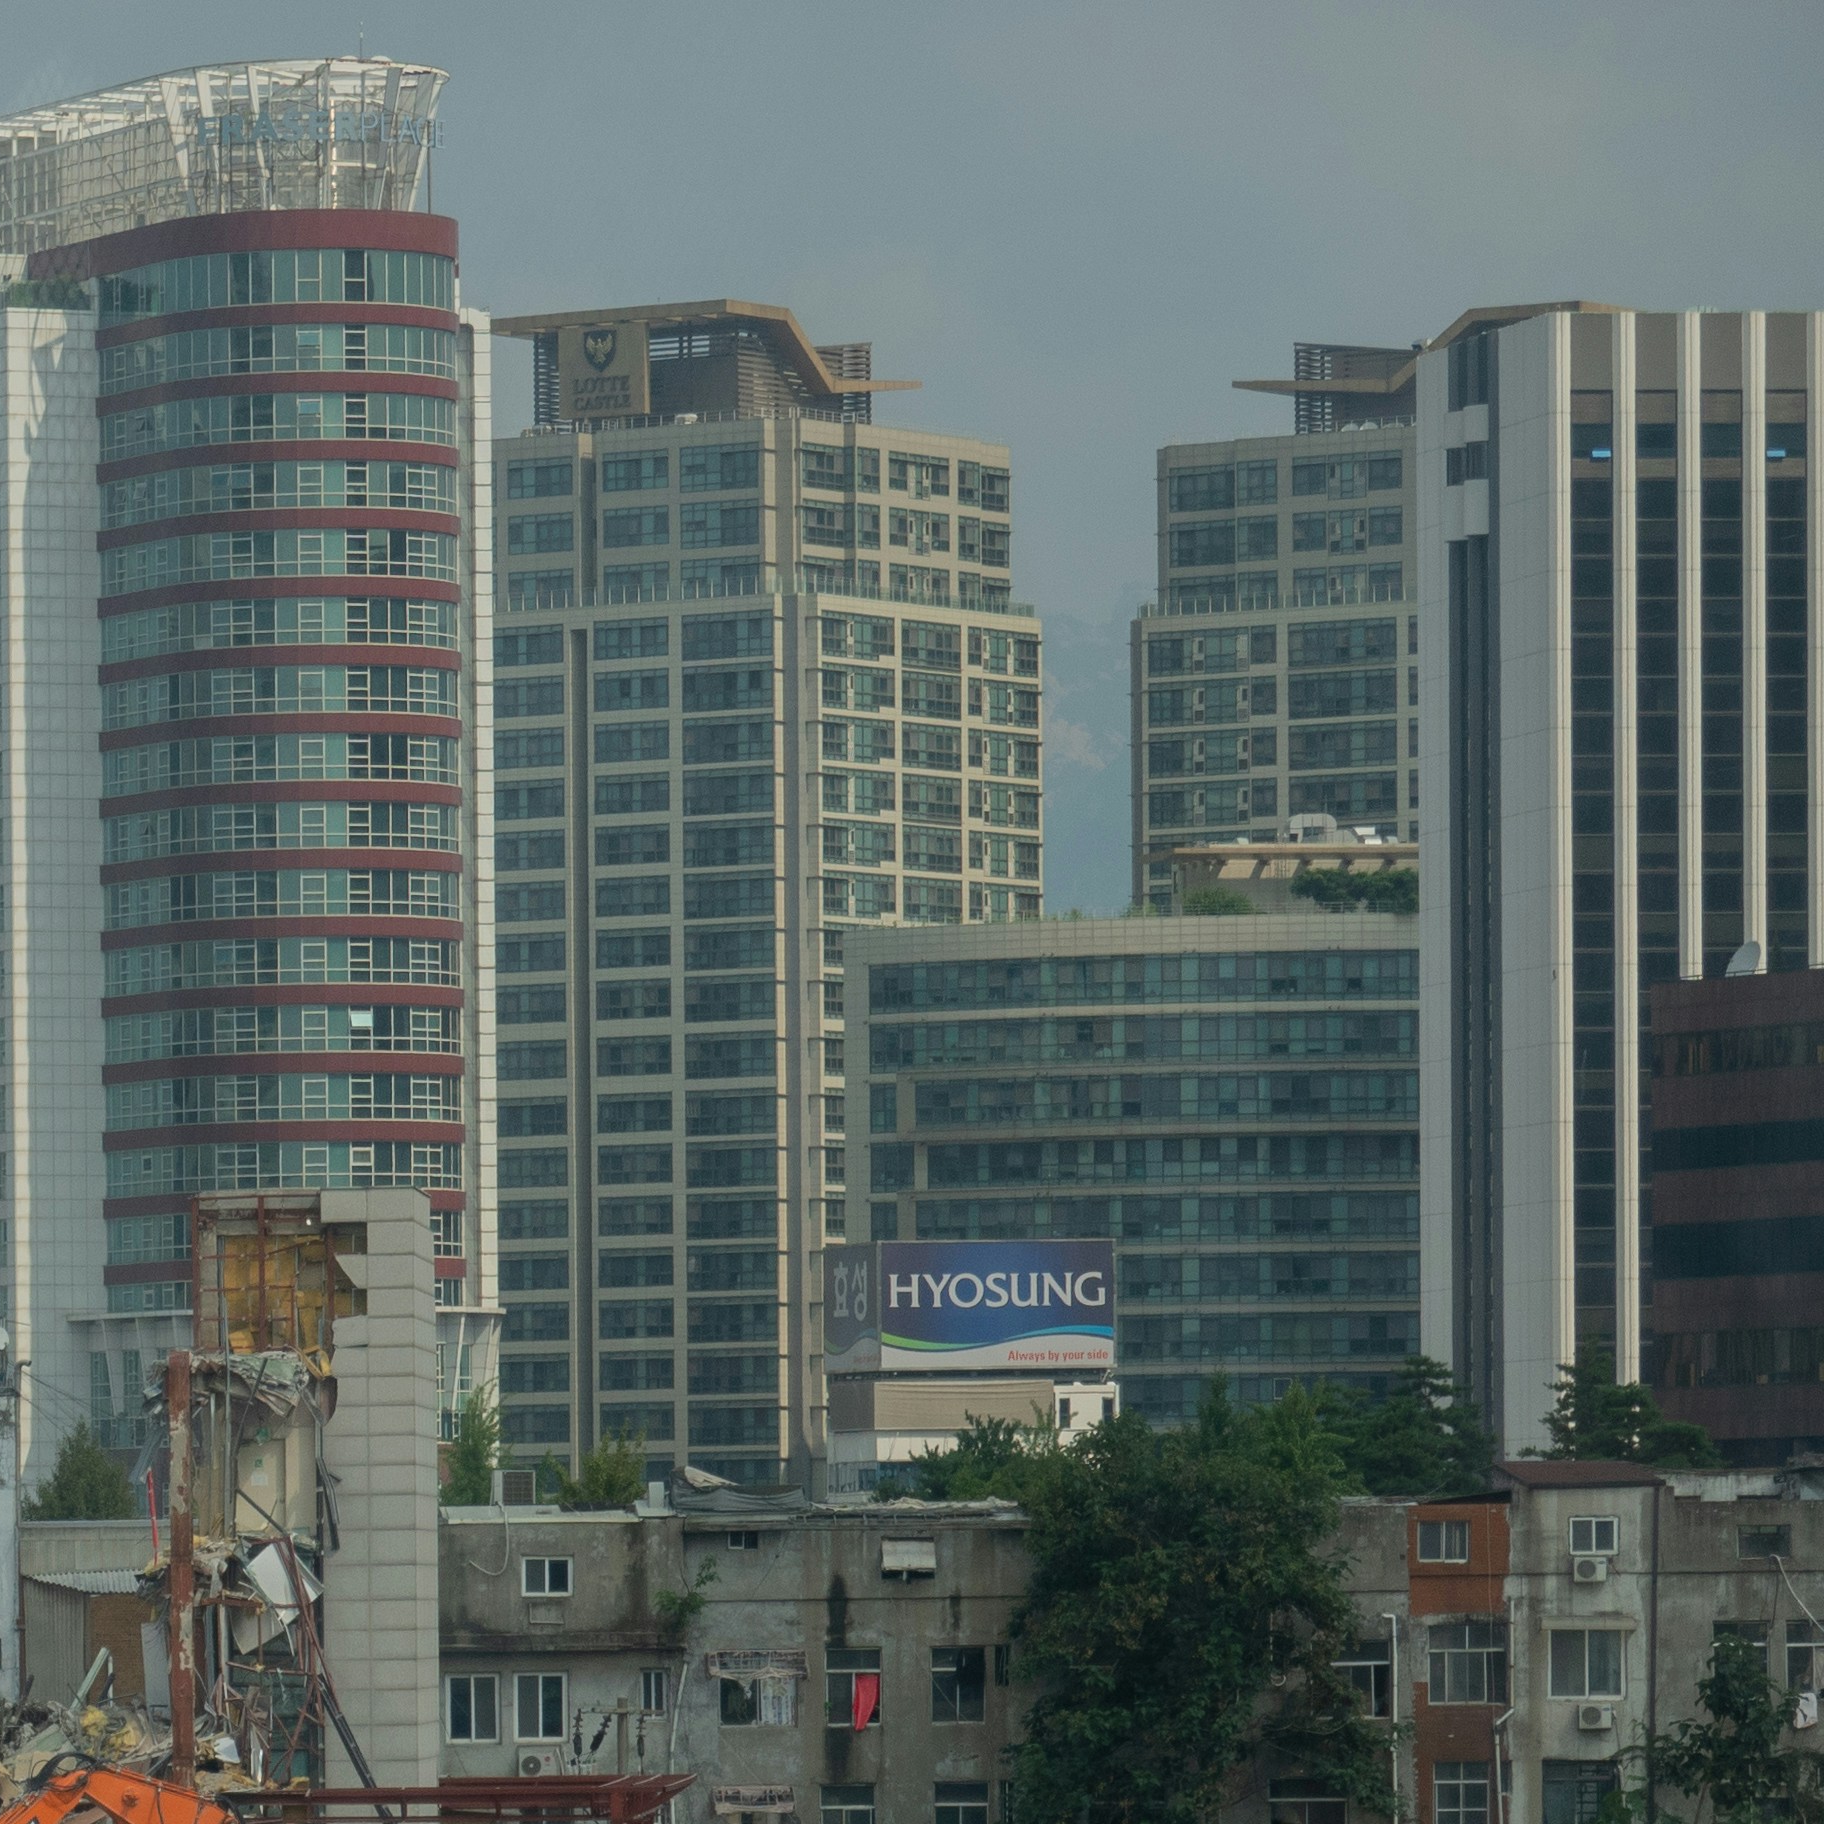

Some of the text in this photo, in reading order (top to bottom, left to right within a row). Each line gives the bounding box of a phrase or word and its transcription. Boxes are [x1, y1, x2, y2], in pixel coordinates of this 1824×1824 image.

[197, 103, 446, 149] FRASER PLACE
[573, 375, 631, 393] LOTTE
[574, 394, 631, 411] CASTLE
[830, 1260, 867, 1322] 효성
[888, 1271, 1106, 1309] HYOSUNG
[1008, 1349, 1109, 1362] Always by your side
